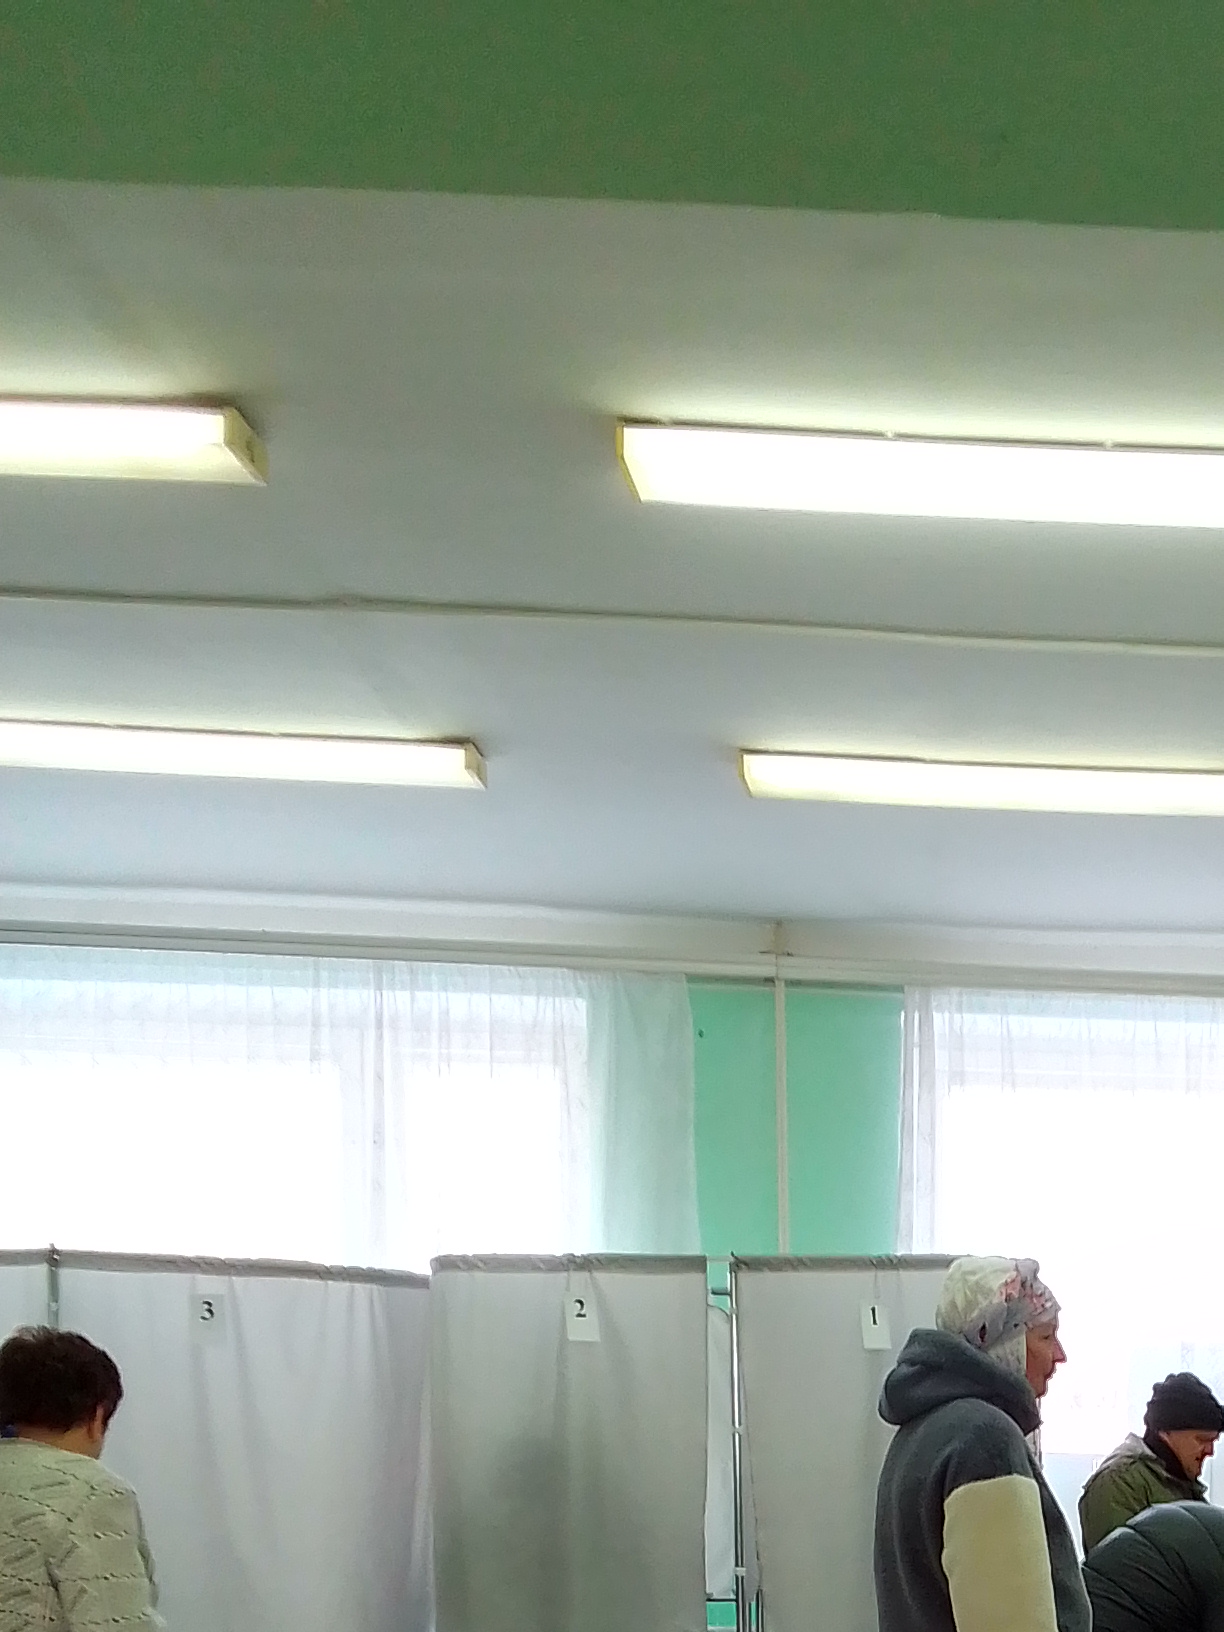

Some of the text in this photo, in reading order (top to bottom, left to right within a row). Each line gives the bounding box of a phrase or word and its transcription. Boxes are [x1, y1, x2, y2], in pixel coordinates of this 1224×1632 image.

[200, 1300, 214, 1321] 3
[573, 1298, 587, 1318] 2
[870, 1306, 878, 1326] 1
